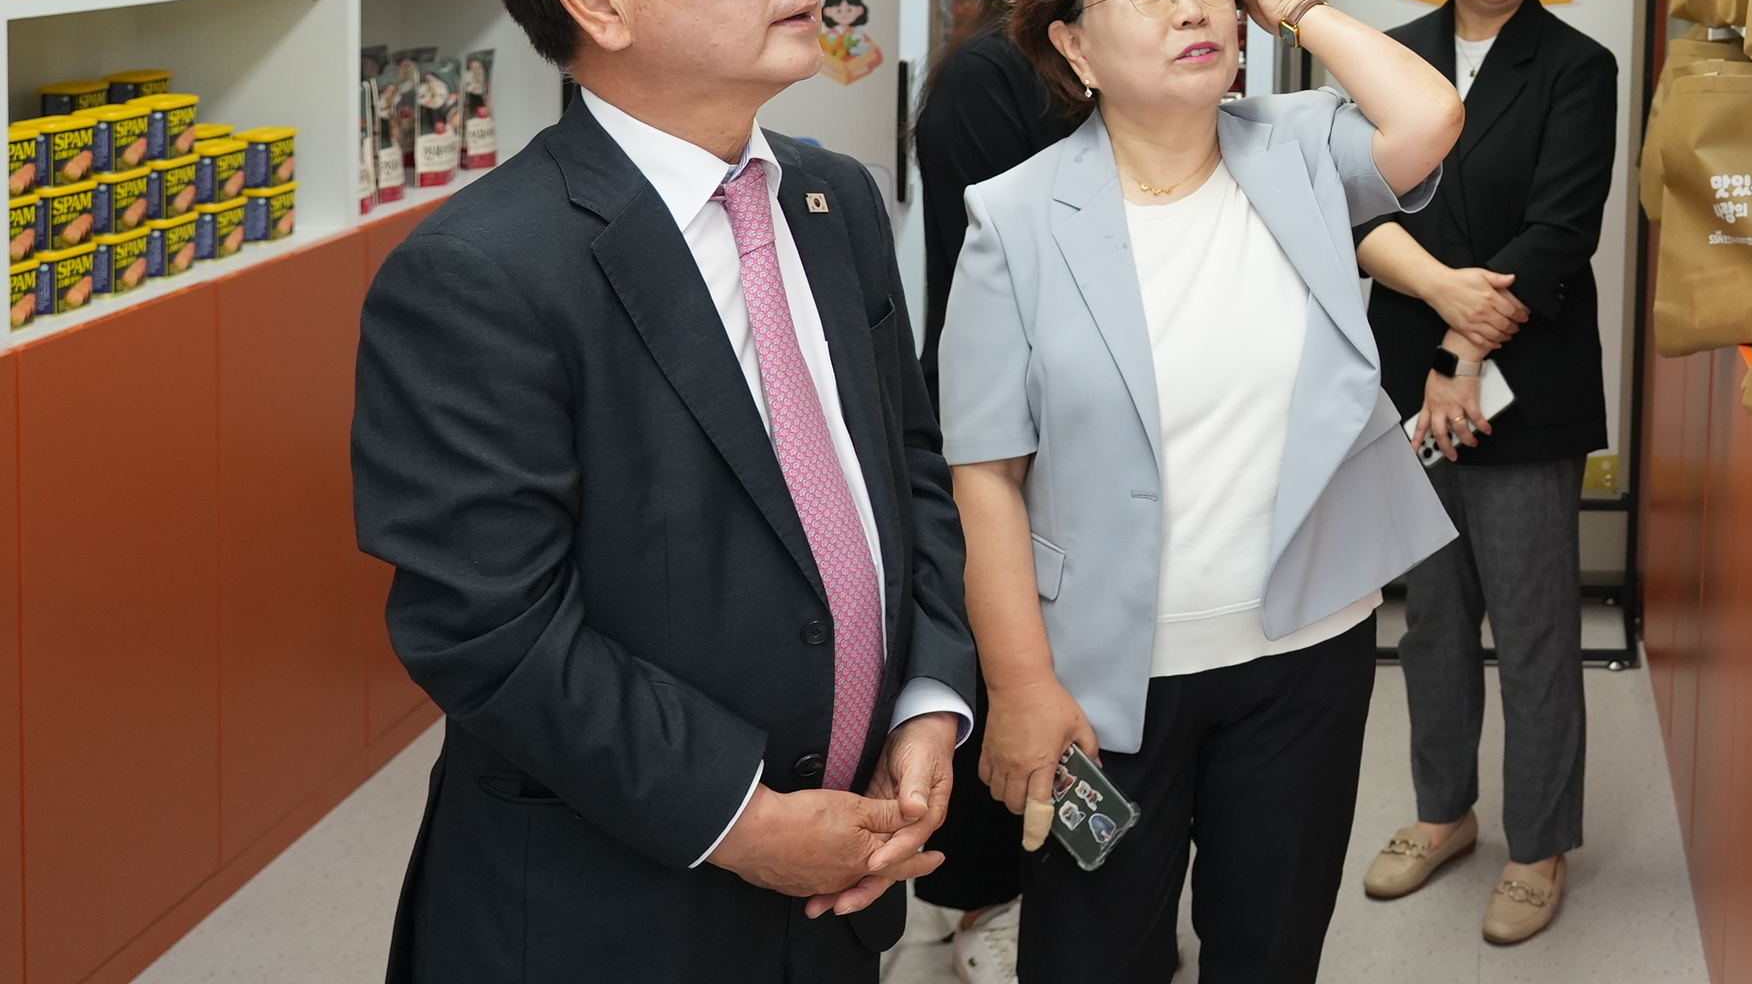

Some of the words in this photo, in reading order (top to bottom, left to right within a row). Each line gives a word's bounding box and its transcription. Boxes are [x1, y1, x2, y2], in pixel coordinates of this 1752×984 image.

[53, 127, 94, 152] SPAM
[115, 116, 148, 139] SPAM
[115, 177, 148, 201] SPAM
[52, 190, 93, 215] SPAM
[115, 237, 148, 262] SPAM
[57, 254, 94, 277] SPAM
